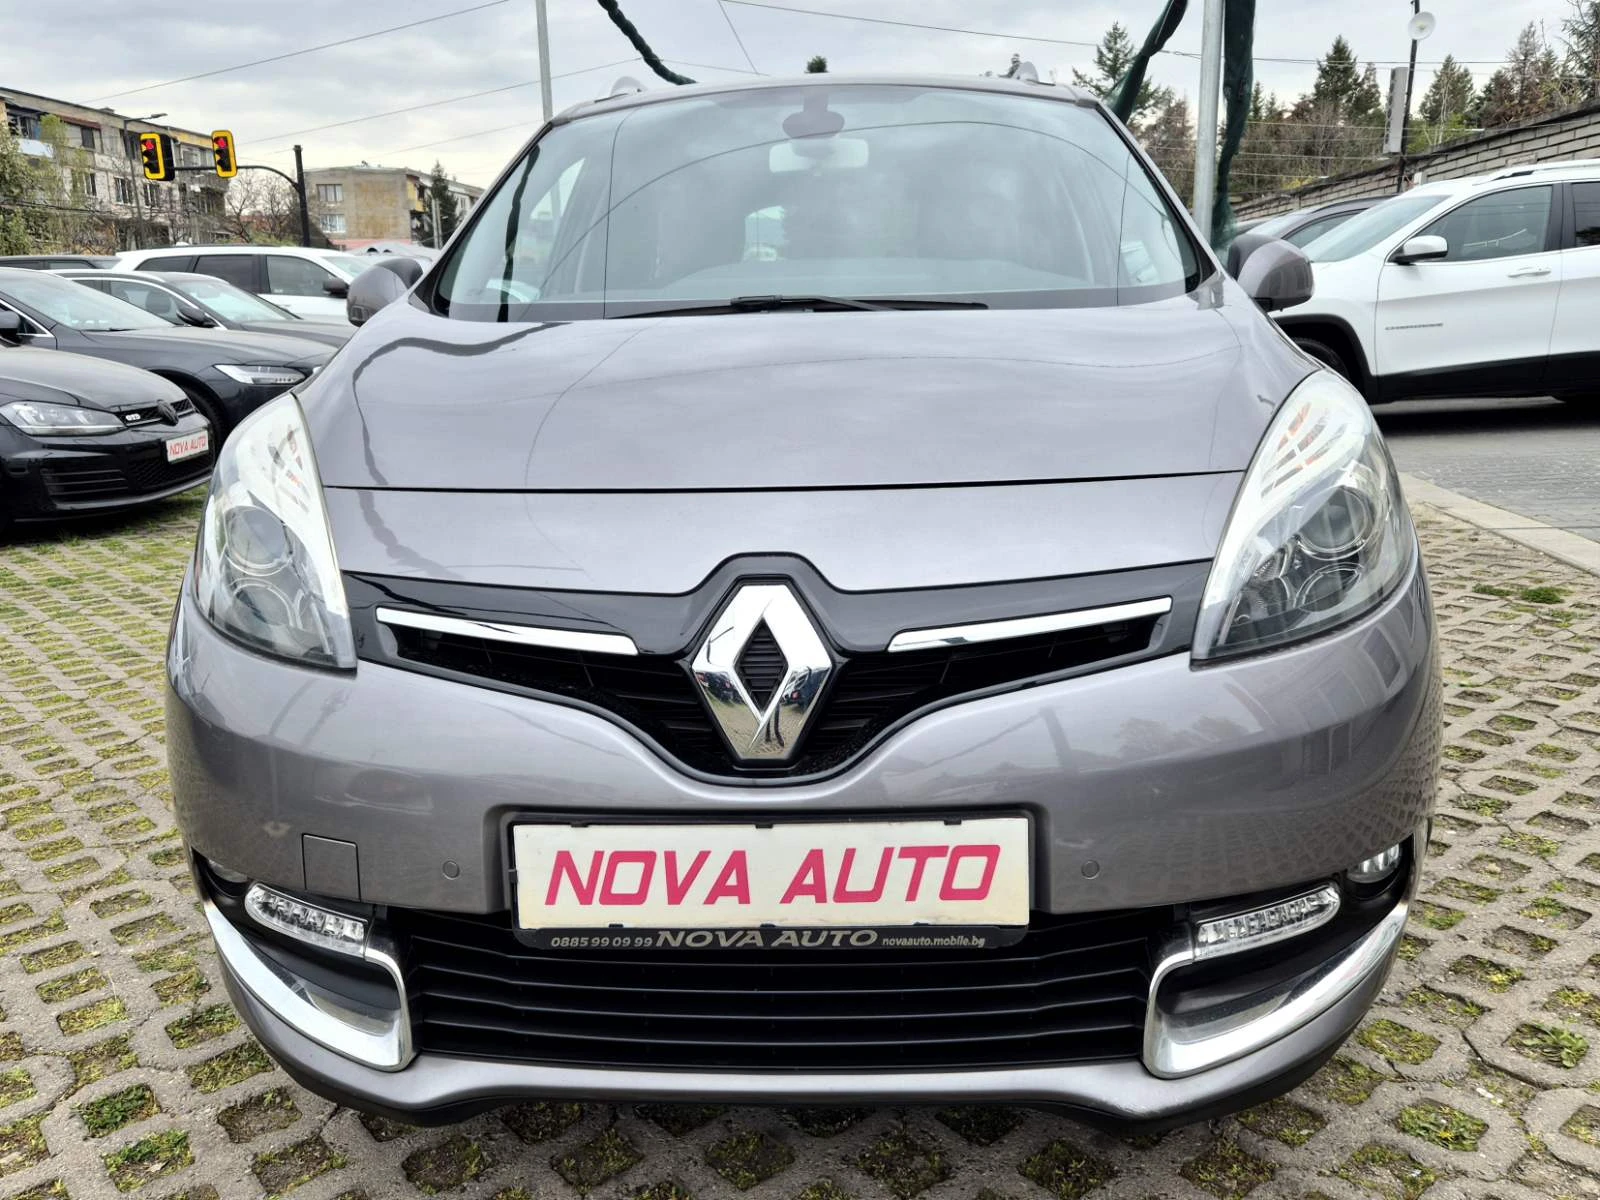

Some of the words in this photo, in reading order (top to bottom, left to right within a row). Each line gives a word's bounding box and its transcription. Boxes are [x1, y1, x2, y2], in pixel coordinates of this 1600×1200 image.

[545, 850, 750, 905] NOVA
[780, 844, 1001, 905] AUTO
[551, 937, 589, 947] 0885
[591, 937, 610, 947] 99
[612, 937, 631, 947] 09
[634, 937, 652, 947] 99
[656, 930, 764, 947] NOVA
[771, 929, 878, 947] AUTO
[882, 935, 985, 948] novaauto.mobile.bg
